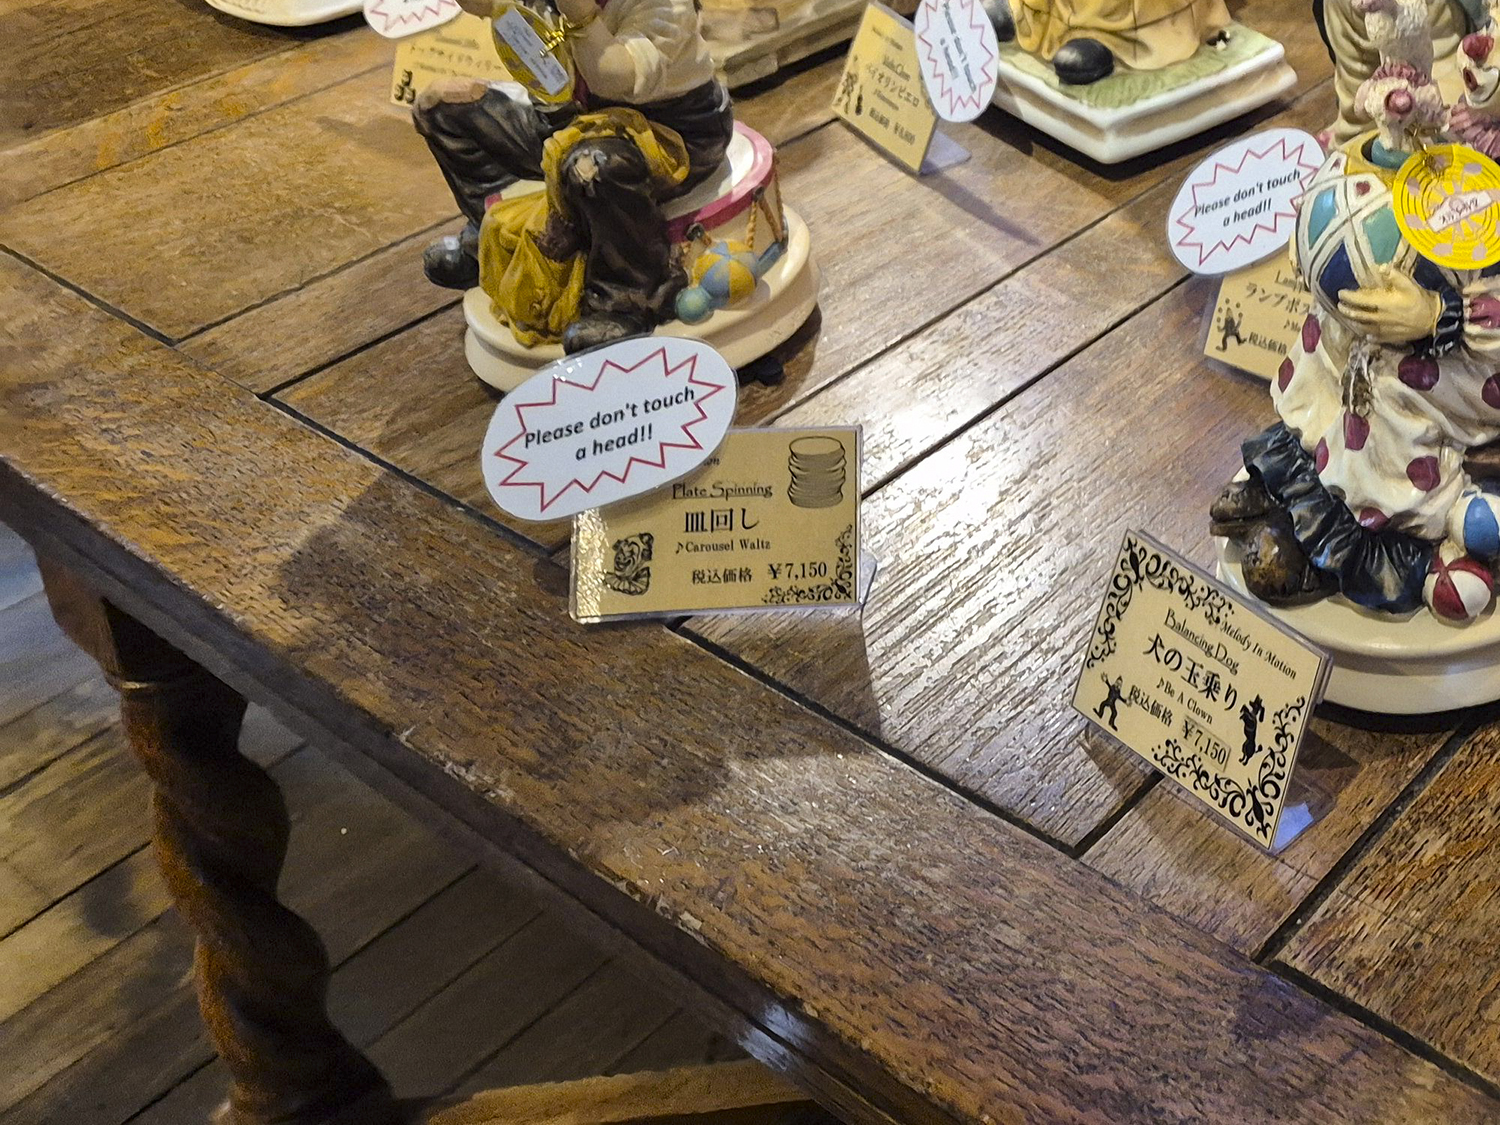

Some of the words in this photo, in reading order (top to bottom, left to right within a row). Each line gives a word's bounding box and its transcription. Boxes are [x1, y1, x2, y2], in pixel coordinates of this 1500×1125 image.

[1193, 196, 1231, 218] Please
[1232, 182, 1264, 207] don't
[1266, 167, 1302, 193] touch
[1223, 214, 1231, 227] a
[1232, 198, 1273, 224] head!!
[524, 420, 584, 449] Please
[589, 401, 638, 430] don't
[642, 385, 696, 415] touch
[575, 445, 587, 462] a
[592, 424, 654, 457] head!!
[671, 483, 707, 500] Plate
[709, 480, 773, 499] Spinning
[683, 508, 761, 534] 皿回し
[684, 538, 735, 554] Carousel
[739, 538, 772, 552] Waltz
[691, 567, 752, 585] 税込価格
[1164, 607, 1213, 658] Balancing
[1213, 643, 1240, 675] Dog
[1219, 620, 1252, 652] Melody
[1253, 642, 1264, 657] In
[1264, 651, 1297, 681] Motion
[1142, 632, 1238, 712] 犬の玉乗り
[1128, 684, 1173, 729] 税込価格
[1164, 681, 1175, 698] Be
[1177, 693, 1185, 706] A
[1187, 698, 1213, 725] Clown
